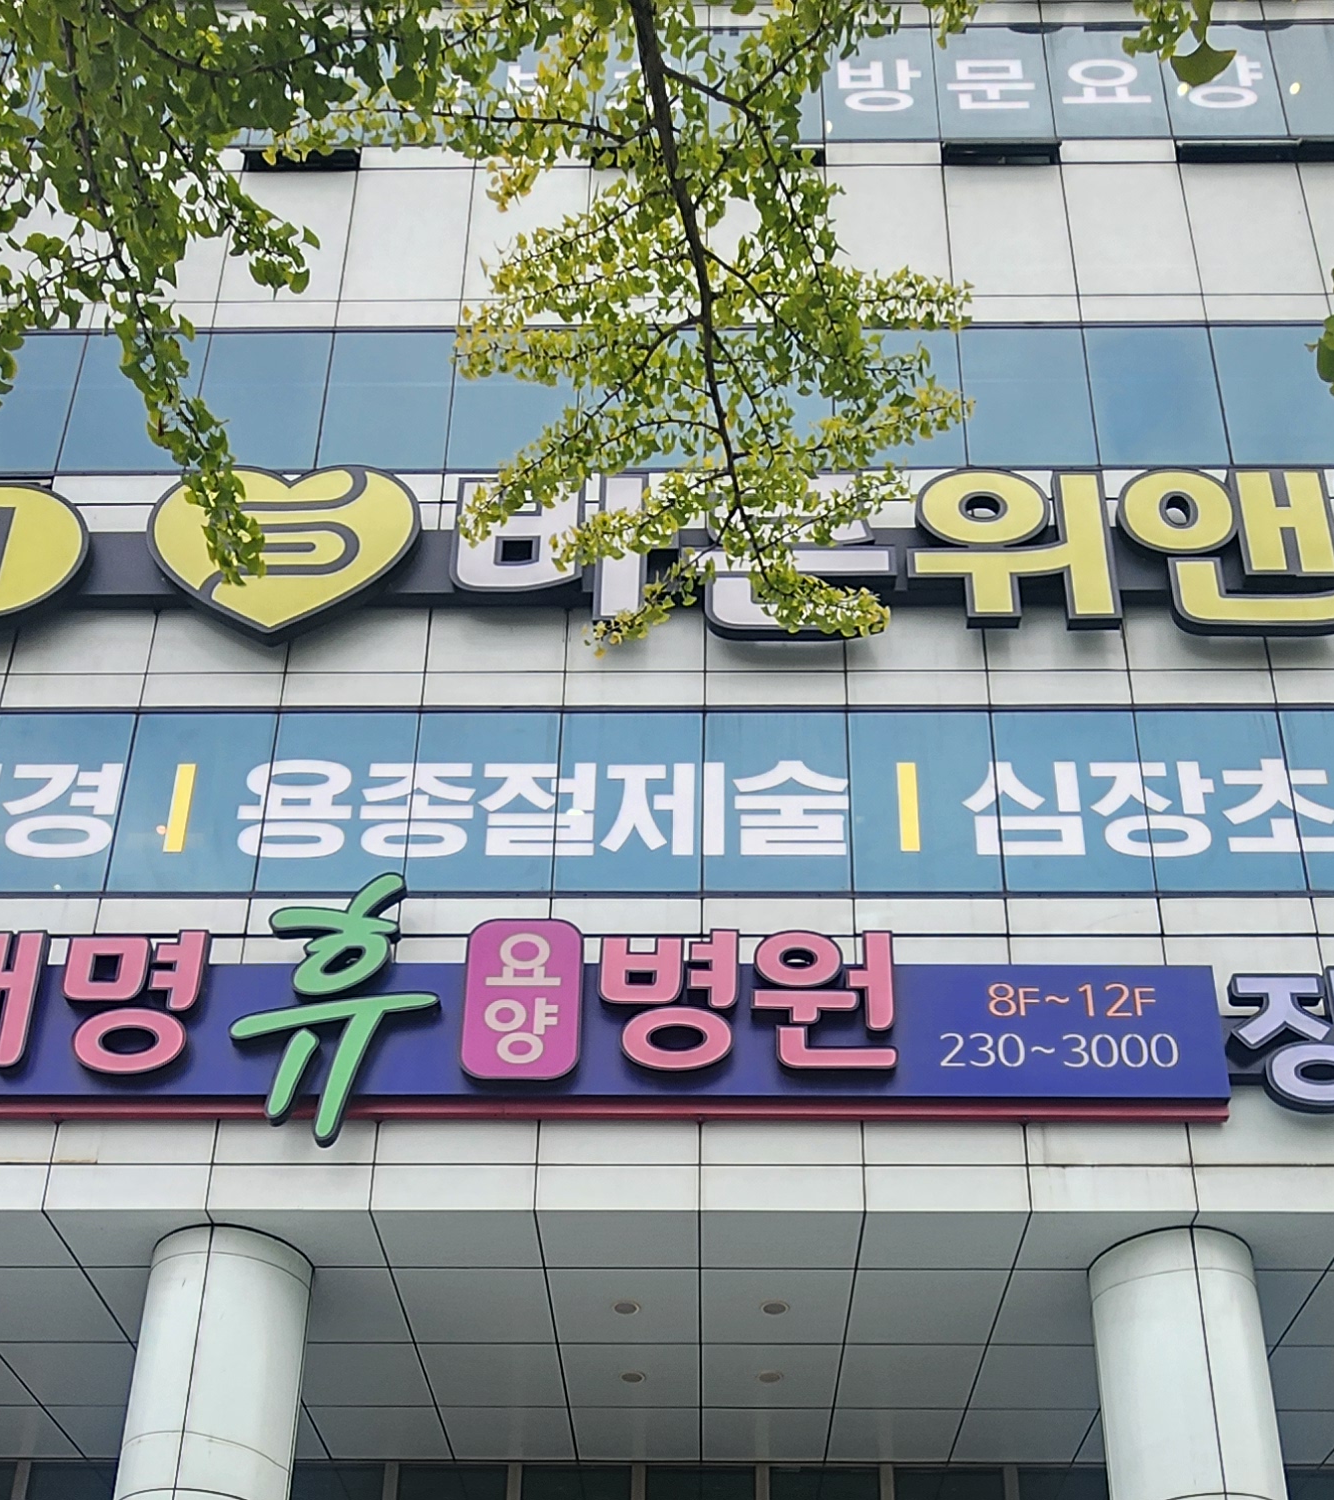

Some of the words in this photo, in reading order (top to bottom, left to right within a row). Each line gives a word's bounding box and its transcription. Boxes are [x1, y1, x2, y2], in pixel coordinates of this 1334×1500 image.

[836, 57, 1264, 111] 방문요양
[235, 759, 850, 858] 용종절제술
[229, 871, 441, 1149] 휴
[483, 930, 559, 1065] 요양
[597, 927, 898, 1072] 병원
[987, 982, 1157, 1018] 8F~12F
[939, 1032, 1180, 1068] 230~3000
